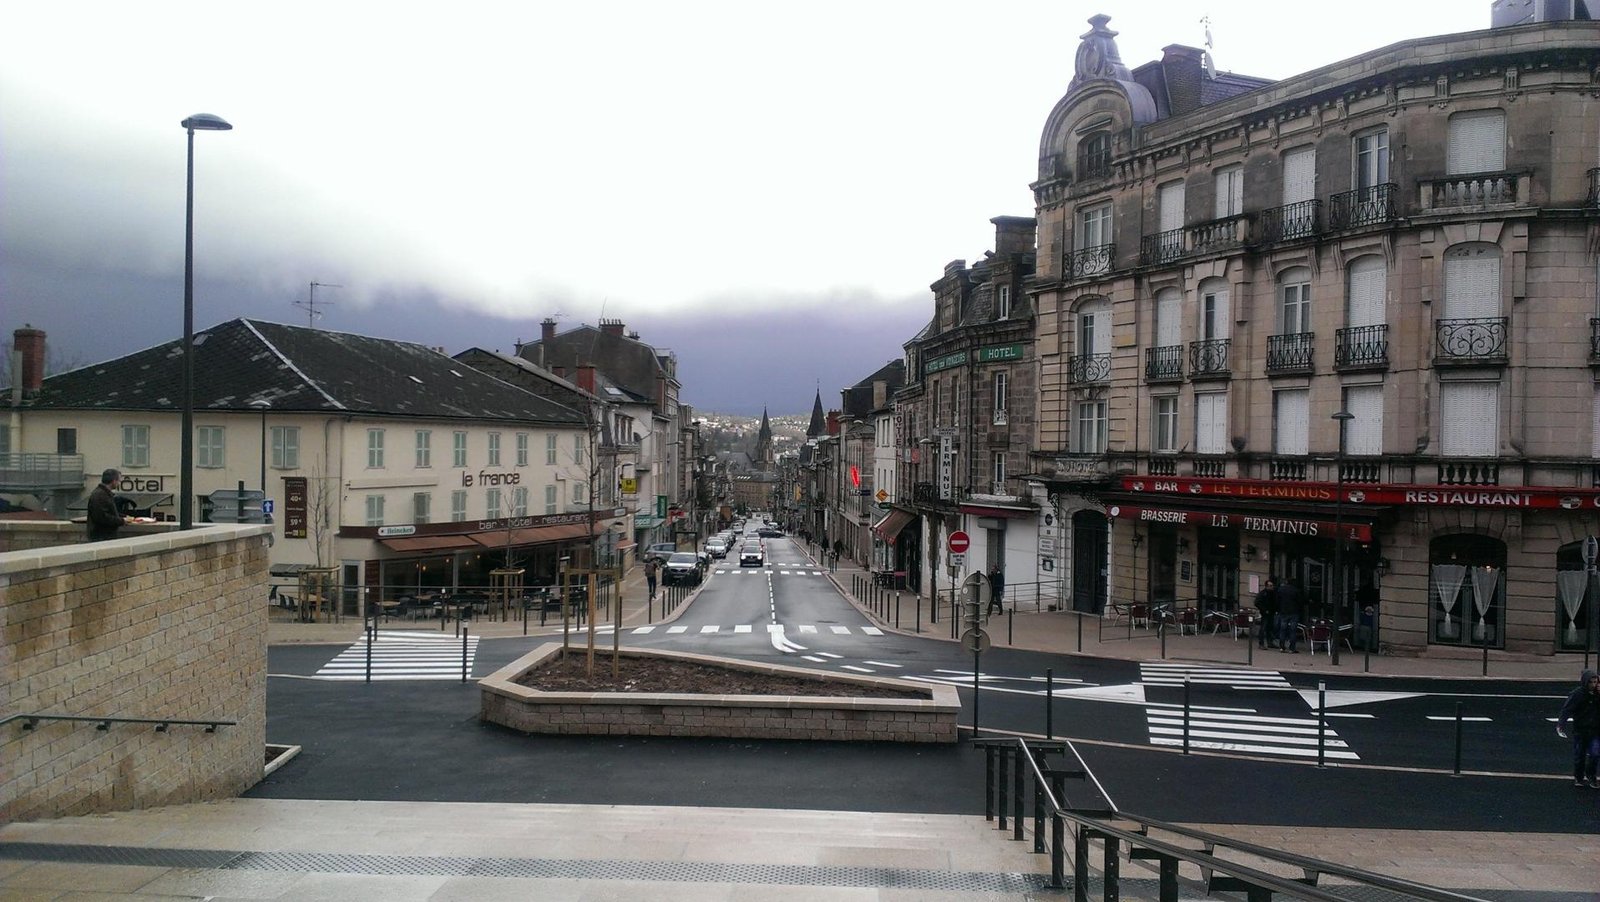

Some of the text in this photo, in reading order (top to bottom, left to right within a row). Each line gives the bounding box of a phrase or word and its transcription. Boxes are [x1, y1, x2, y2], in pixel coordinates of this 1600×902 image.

[988, 347, 1016, 359] HOTEL
[942, 438, 951, 497] TERMINUS
[462, 470, 520, 487] le france
[1154, 481, 1179, 492] BAR
[1213, 484, 1232, 495] LE
[1238, 484, 1331, 500] TERMINUS
[1405, 490, 1534, 506] RESTAURANT
[479, 520, 497, 530] bar
[1141, 509, 1318, 536] BRASSERIE LE TERMINUS
